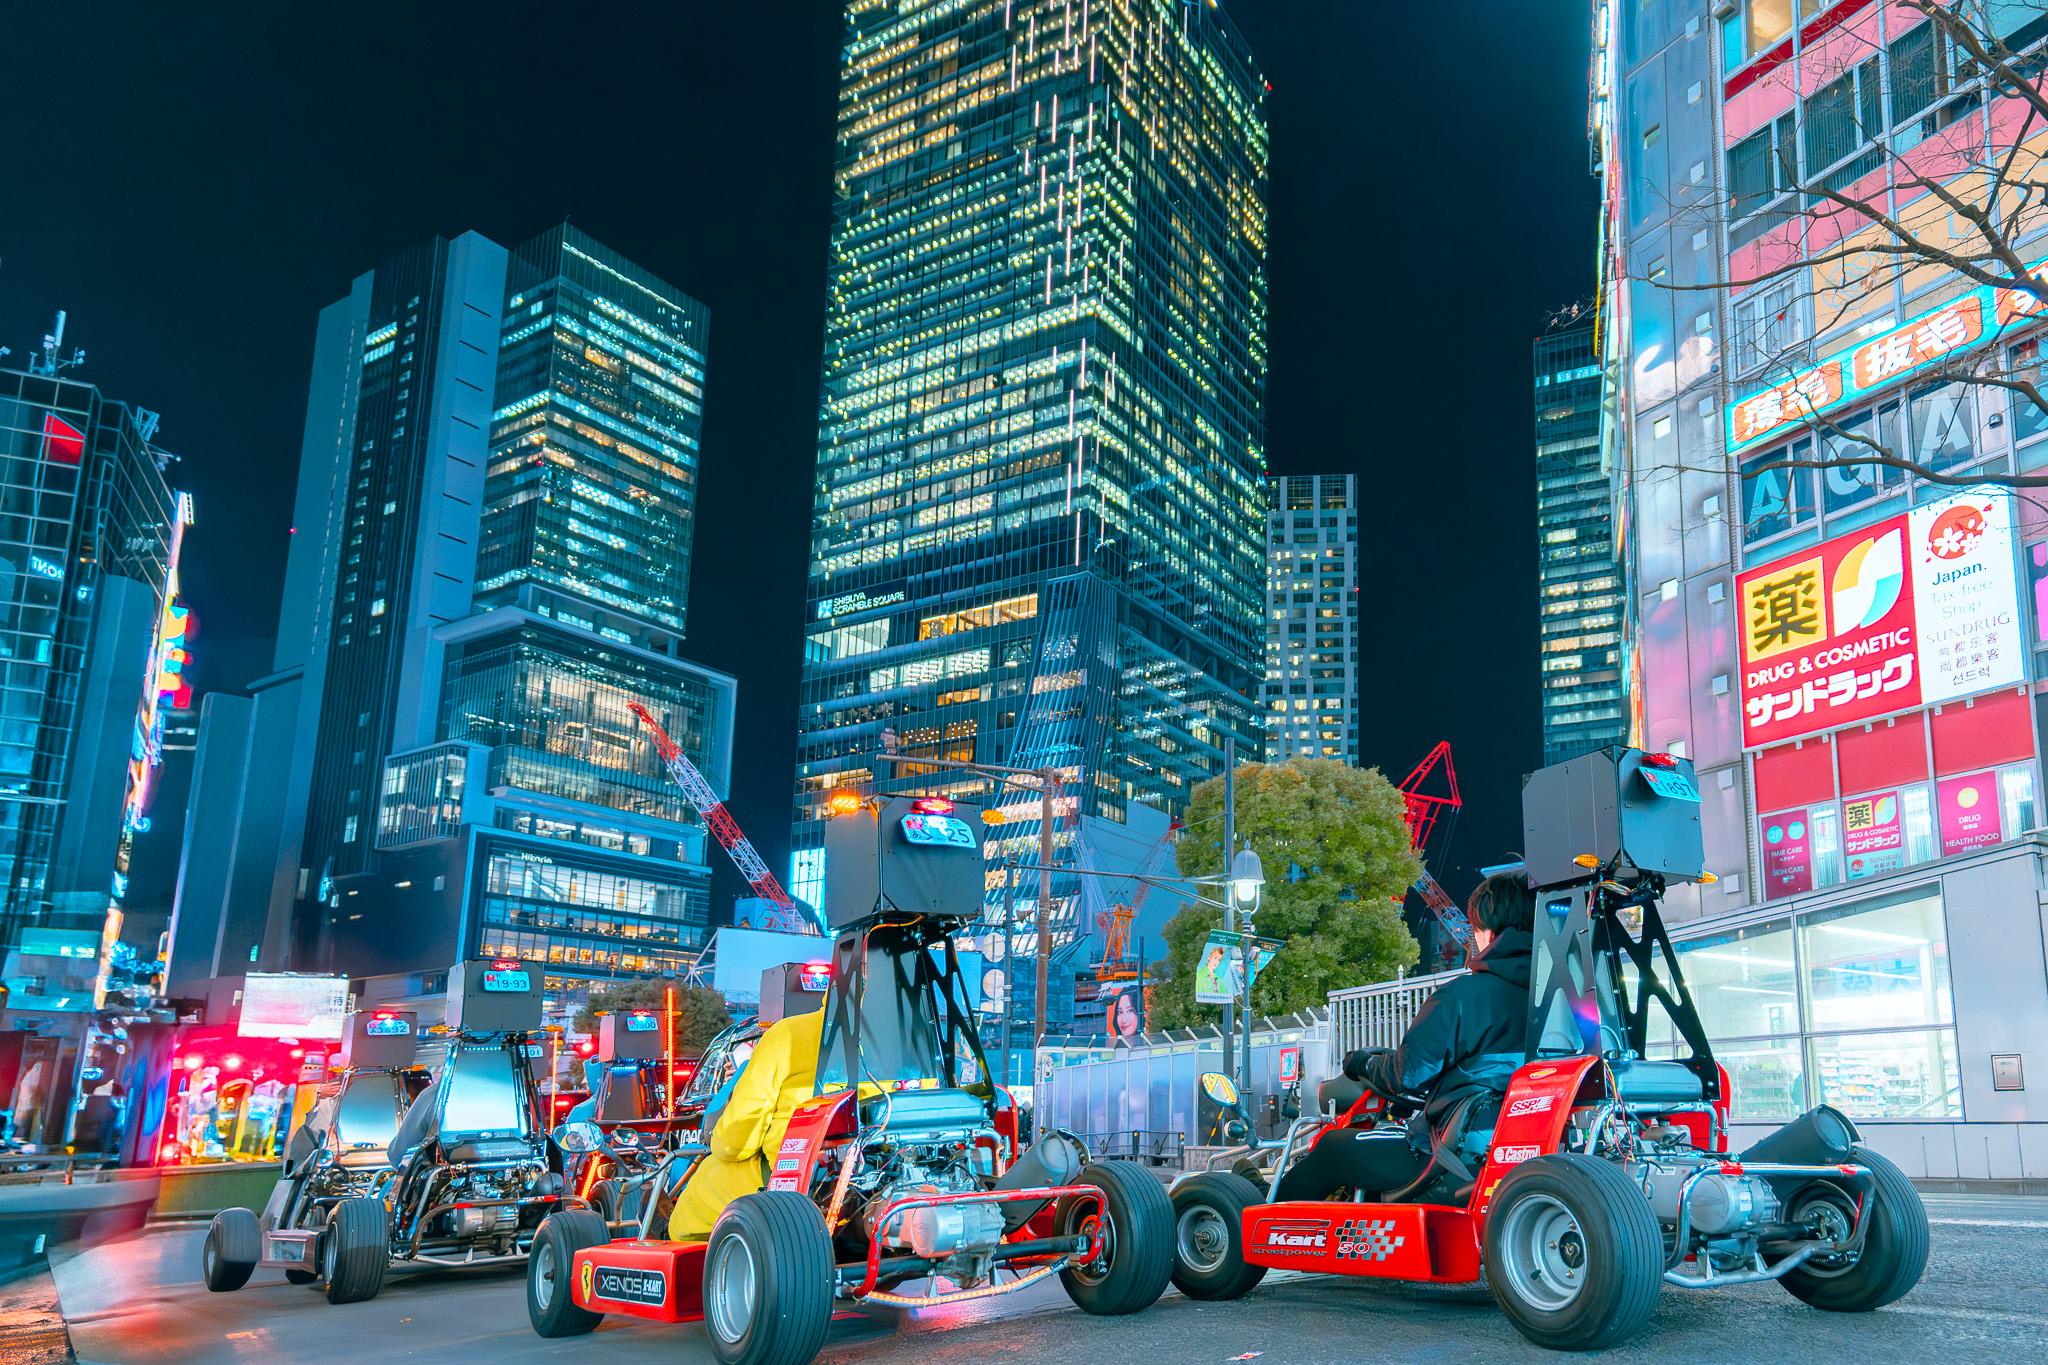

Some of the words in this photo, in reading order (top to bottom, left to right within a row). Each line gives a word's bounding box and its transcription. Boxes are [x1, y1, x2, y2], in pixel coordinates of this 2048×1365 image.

[833, 598, 872, 615] SCRAMBLE
[872, 591, 904, 606] SQUARE
[834, 592, 866, 606] SHIBUYA
[1752, 570, 1818, 652] 薬
[1926, 612, 2010, 645] SUNDRUG
[1748, 662, 1796, 688] DRUG
[1799, 656, 1814, 674] &
[1814, 627, 1911, 668] COSMETIC
[1953, 666, 1990, 686] 선드럭
[1746, 653, 1914, 727] サンドラッグ
[1848, 804, 1871, 828] 薬
[1848, 831, 1864, 840] DRUG
[1870, 825, 1898, 836] COSMETIC
[1945, 837, 1974, 848] HEALTH
[1975, 832, 2000, 842] FOOD
[1848, 833, 1900, 852] サンドラッグ
[1772, 849, 1786, 858] HAIR
[1786, 846, 1804, 855] CARE
[1788, 866, 1805, 874] CARE
[1504, 1147, 1538, 1162] Castrol
[1268, 1232, 1326, 1247] Kart
[1337, 1242, 1370, 1254] 50
[1252, 1247, 1328, 1257] streetpower
[601, 1274, 642, 1294] XENOS
